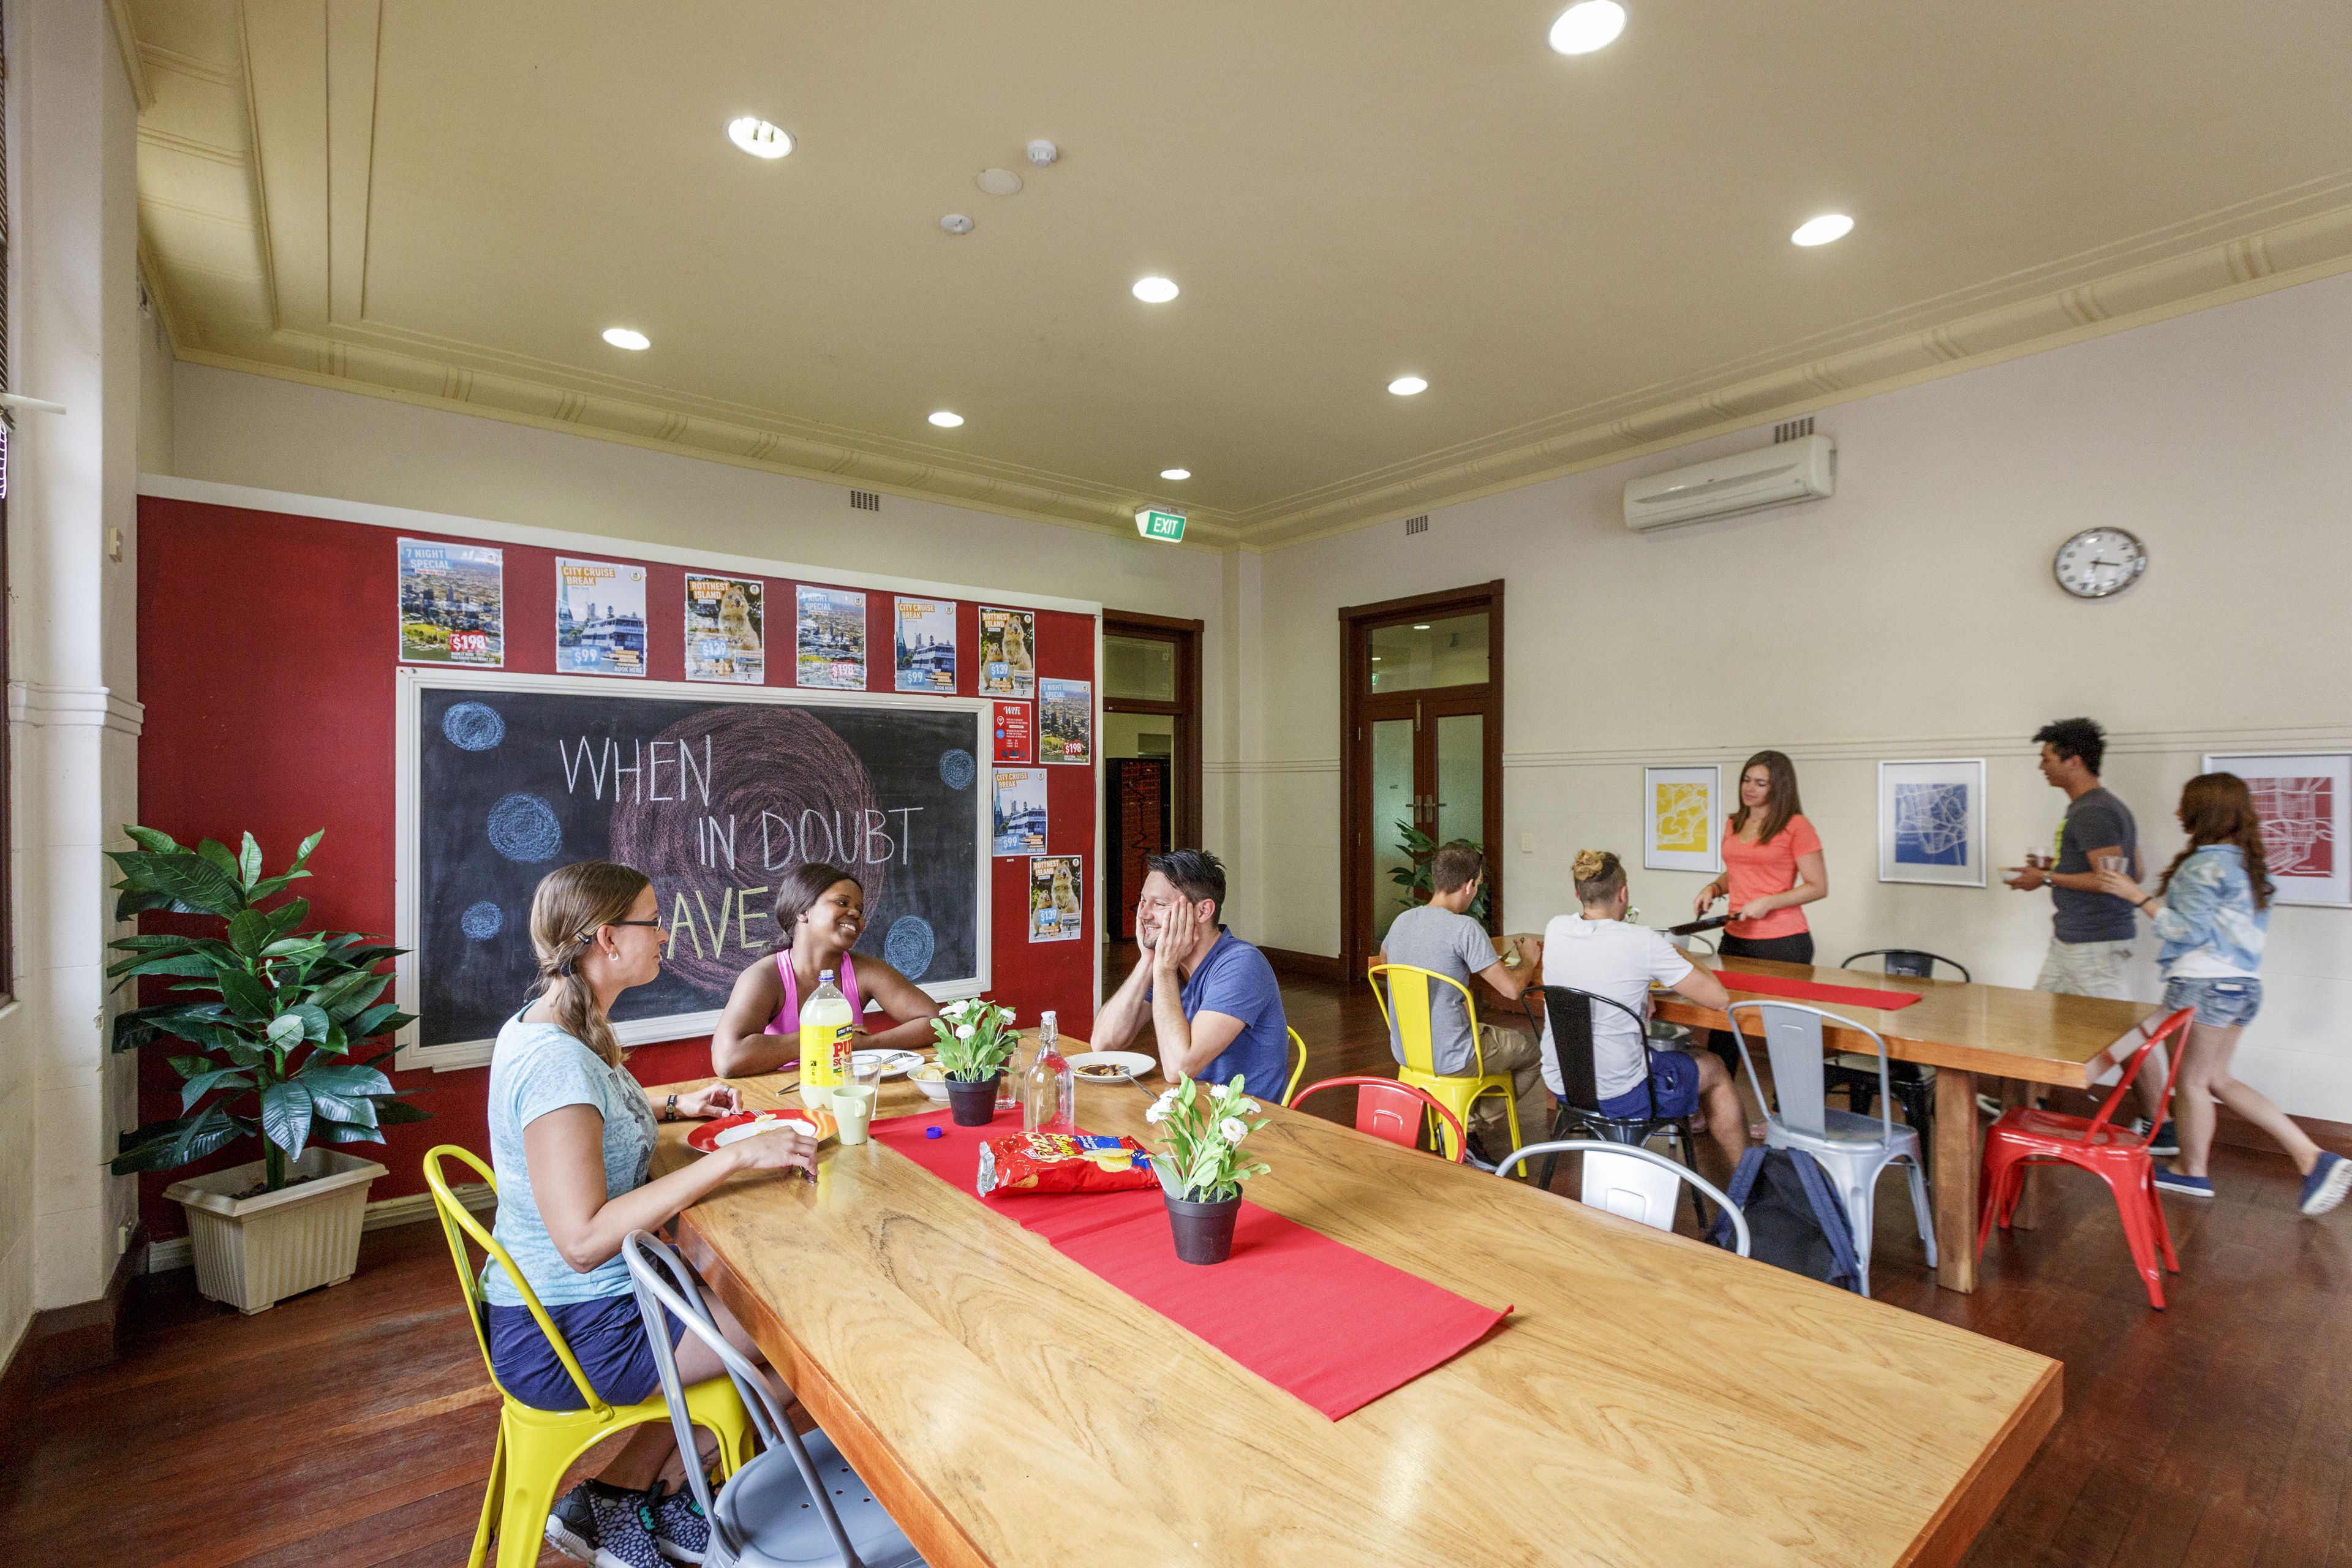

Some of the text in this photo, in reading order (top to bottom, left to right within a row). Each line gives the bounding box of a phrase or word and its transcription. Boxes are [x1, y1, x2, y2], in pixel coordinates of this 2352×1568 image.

[1153, 517, 1178, 535] EXIT
[405, 548, 445, 559] 7 NIGHT
[410, 559, 451, 569] SPECIAL
[563, 567, 614, 577] CITY CRUISE
[567, 576, 595, 585] BREAK
[692, 582, 729, 590] ROTTNEST
[695, 590, 721, 599] ISLAND
[453, 635, 485, 651] $198
[703, 642, 726, 657] $139
[575, 649, 597, 663] $99
[991, 664, 1008, 676] $139
[908, 671, 923, 684] $99
[1066, 743, 1082, 755] $198
[559, 734, 711, 807] WHEN
[699, 807, 924, 871] IN DOUBT
[1003, 837, 1017, 849] $99
[1034, 861, 1059, 869] ROTTNEST
[1036, 868, 1054, 876] ISLAND
[1040, 909, 1057, 922] $139
[666, 886, 769, 960] AVE
[833, 1039, 853, 1058] PU
